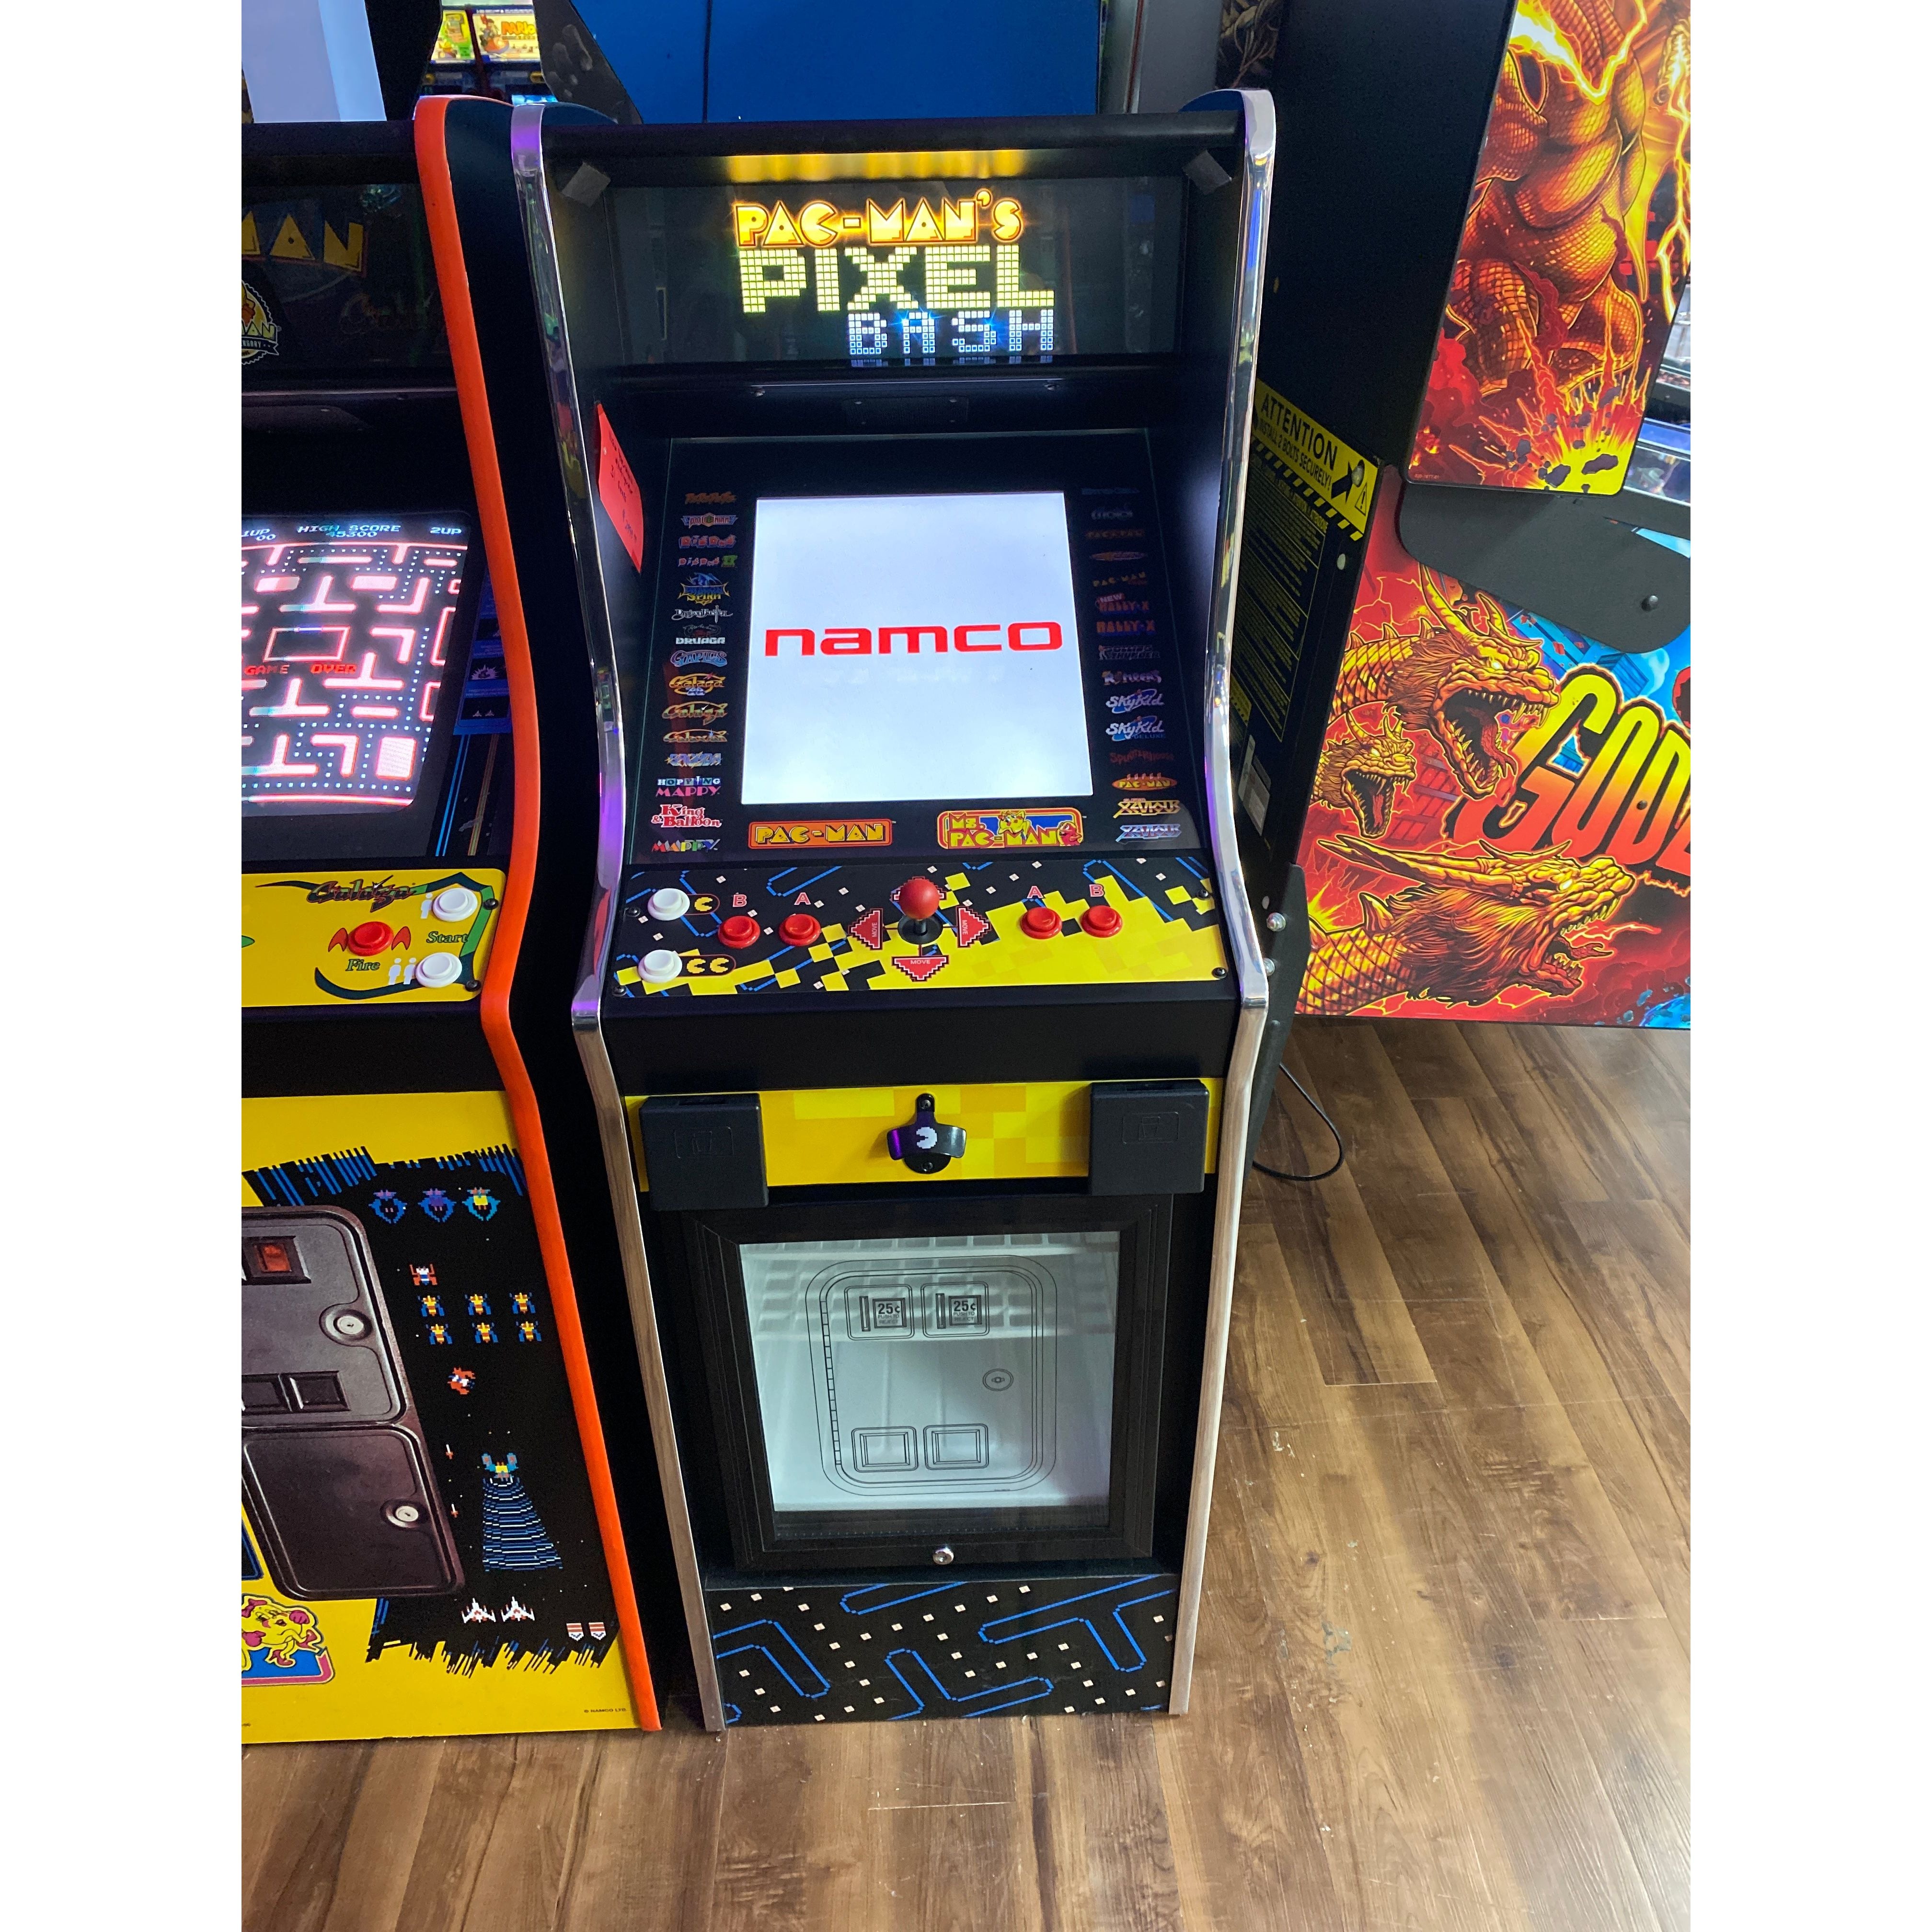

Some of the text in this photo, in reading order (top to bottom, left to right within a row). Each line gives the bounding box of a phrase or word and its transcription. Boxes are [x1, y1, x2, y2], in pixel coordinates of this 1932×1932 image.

[735, 188, 1024, 247] PAC-MAN'S
[739, 244, 1055, 313] PIXEL
[848, 309, 1054, 355] BASH
[1261, 392, 1338, 472] ATTENTION
[1299, 453, 1333, 491] SECURELY!
[297, 525, 340, 533] HIGH
[1100, 593, 1123, 602] NEW
[764, 621, 1063, 656] namco
[310, 664, 356, 674] OVER
[1119, 780, 1171, 788] PAC-MAN
[656, 786, 721, 797] MAPPY
[661, 804, 705, 818] King
[651, 815, 722, 828] & Balloon
[755, 823, 886, 844] PAC-MAN
[950, 830, 1058, 848] PAC-MAN
[652, 839, 721, 852] MAPPY
[307, 875, 415, 913] Galaga
[1027, 885, 1045, 899] A
[1089, 884, 1104, 897] B
[732, 894, 748, 908] B
[794, 891, 811, 905] A
[426, 931, 468, 944] Start
[345, 958, 380, 971] Fire
[877, 1303, 900, 1314] 25¢
[954, 1300, 976, 1311] 25¢
